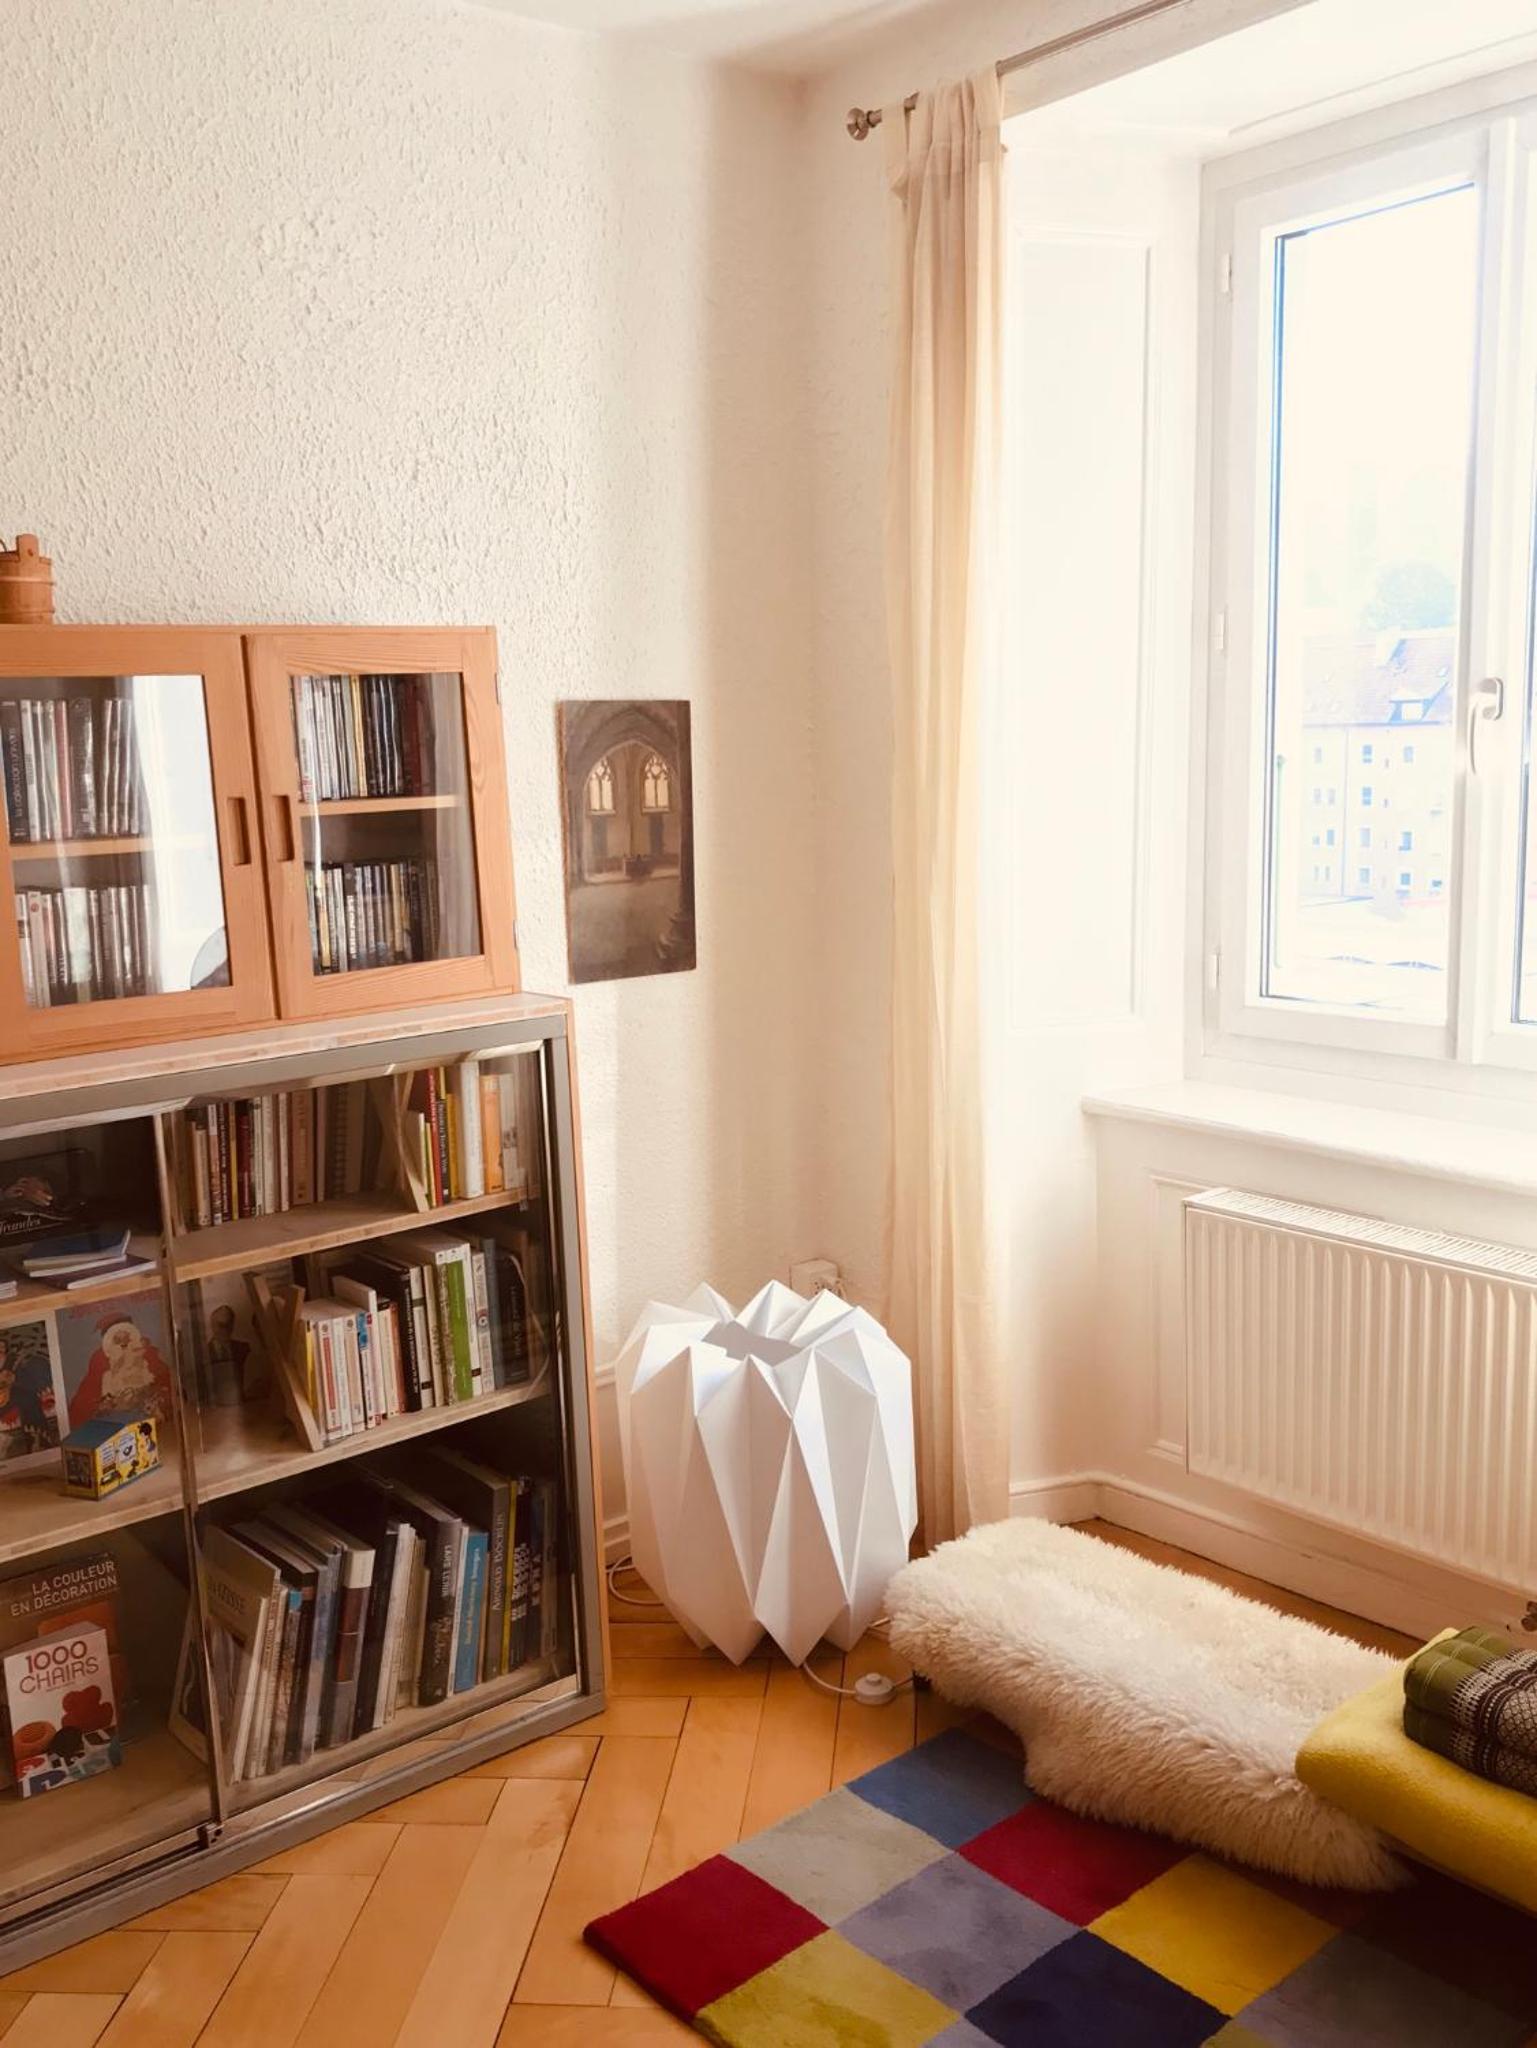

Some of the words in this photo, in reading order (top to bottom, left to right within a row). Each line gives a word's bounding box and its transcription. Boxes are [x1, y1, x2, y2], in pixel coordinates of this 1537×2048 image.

[32, 1581, 51, 1596] LA
[53, 1560, 115, 1588] COULEUR
[10, 1601, 31, 1616] EN
[25, 1640, 88, 1674] 1000
[19, 1656, 100, 1694] CHAIRS
